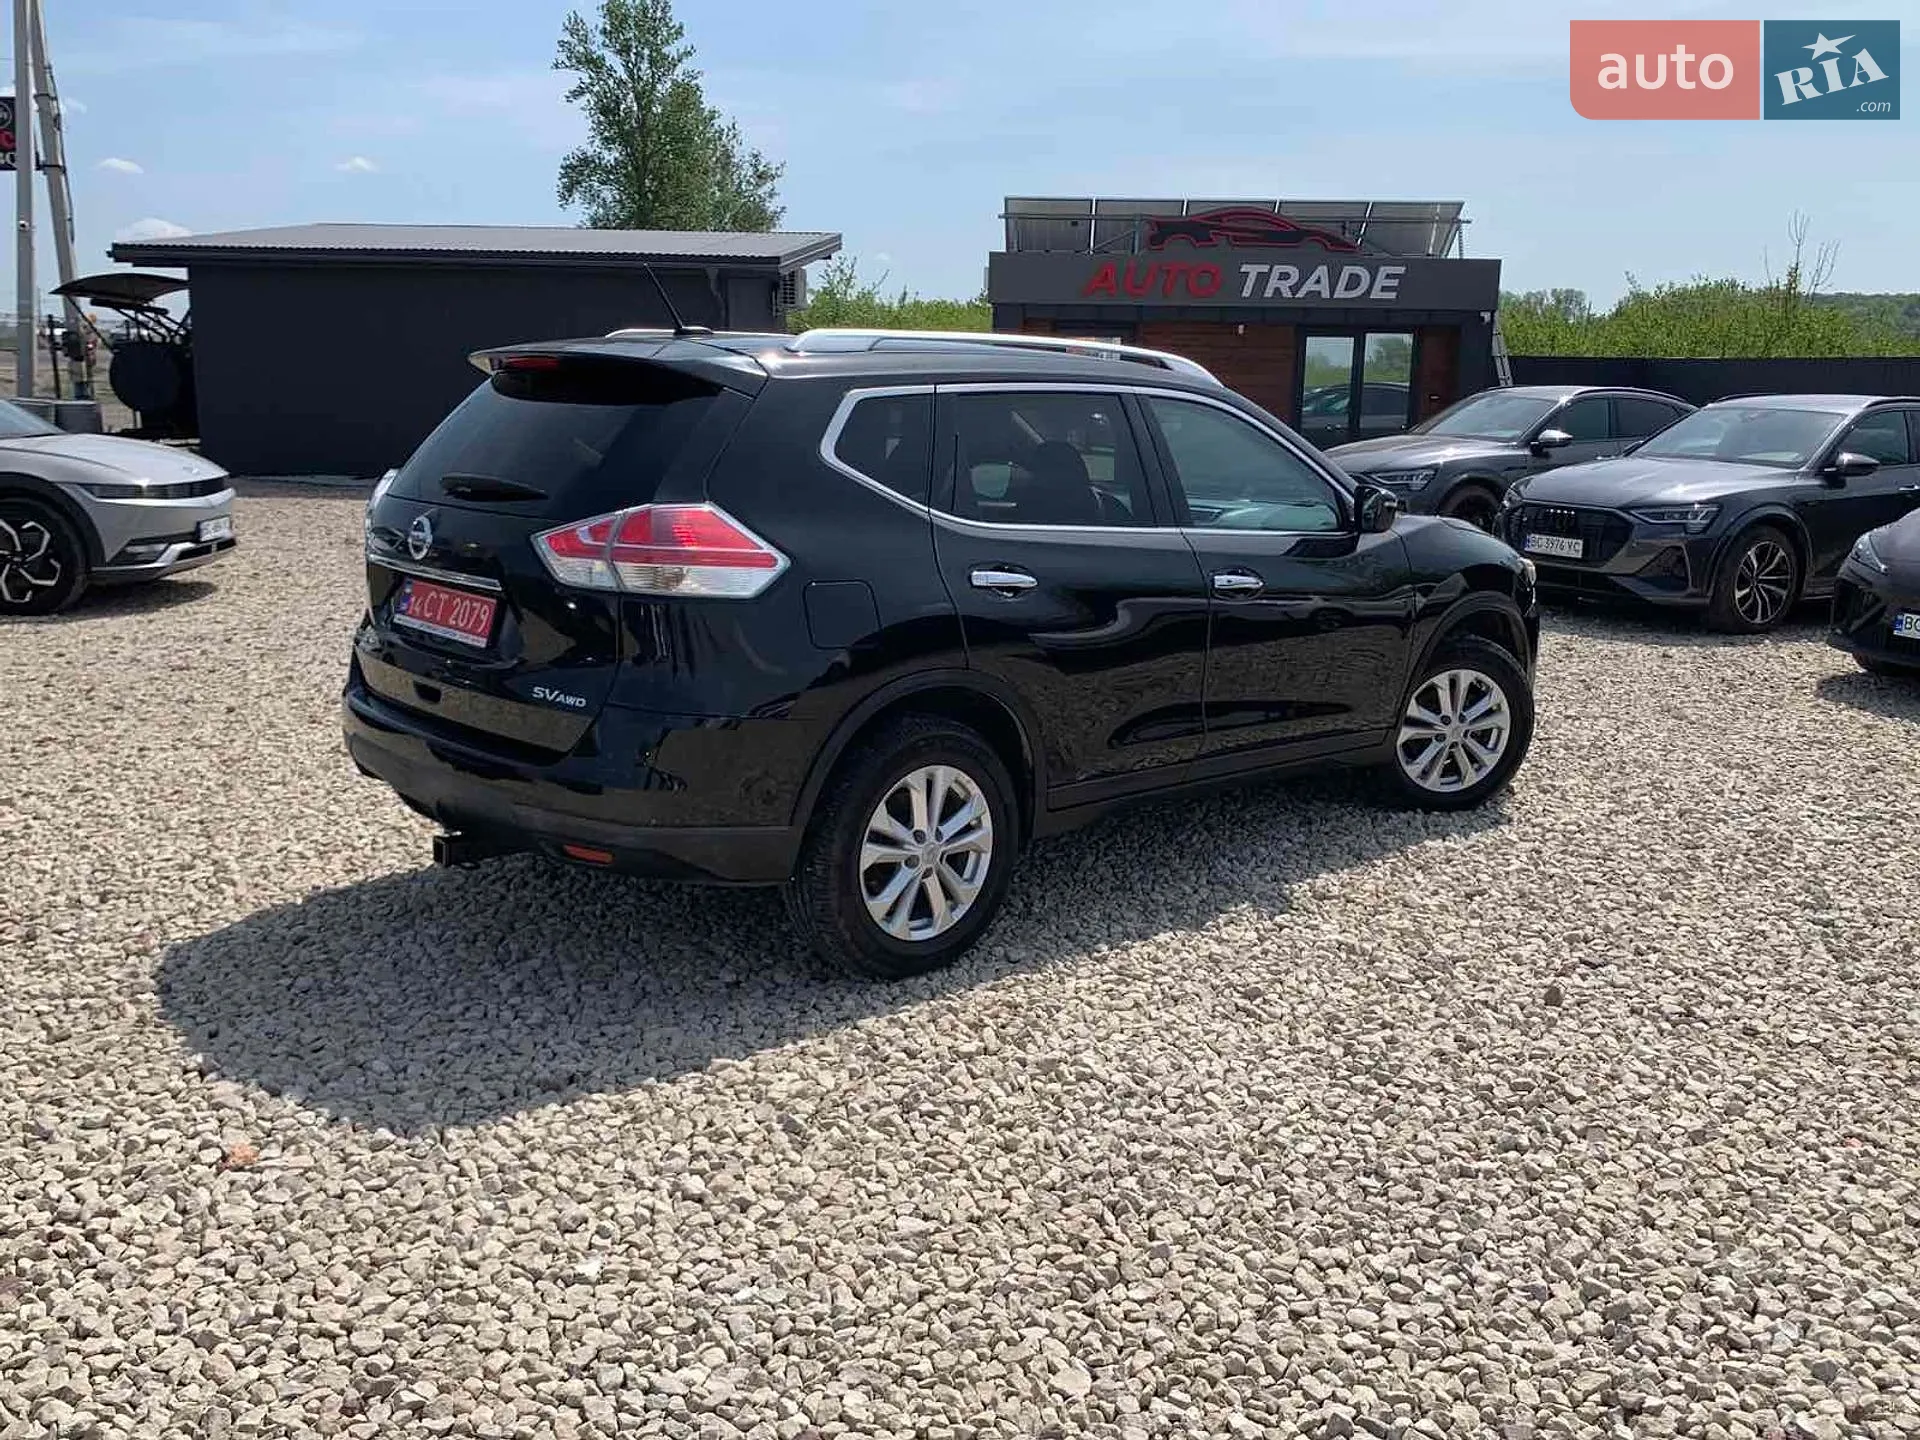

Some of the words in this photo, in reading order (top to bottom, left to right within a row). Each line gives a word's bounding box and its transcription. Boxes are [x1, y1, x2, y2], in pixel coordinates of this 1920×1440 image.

[1083, 260, 1224, 298] AUTO
[1239, 263, 1407, 299] TRADE
[449, 597, 490, 633] 2079
